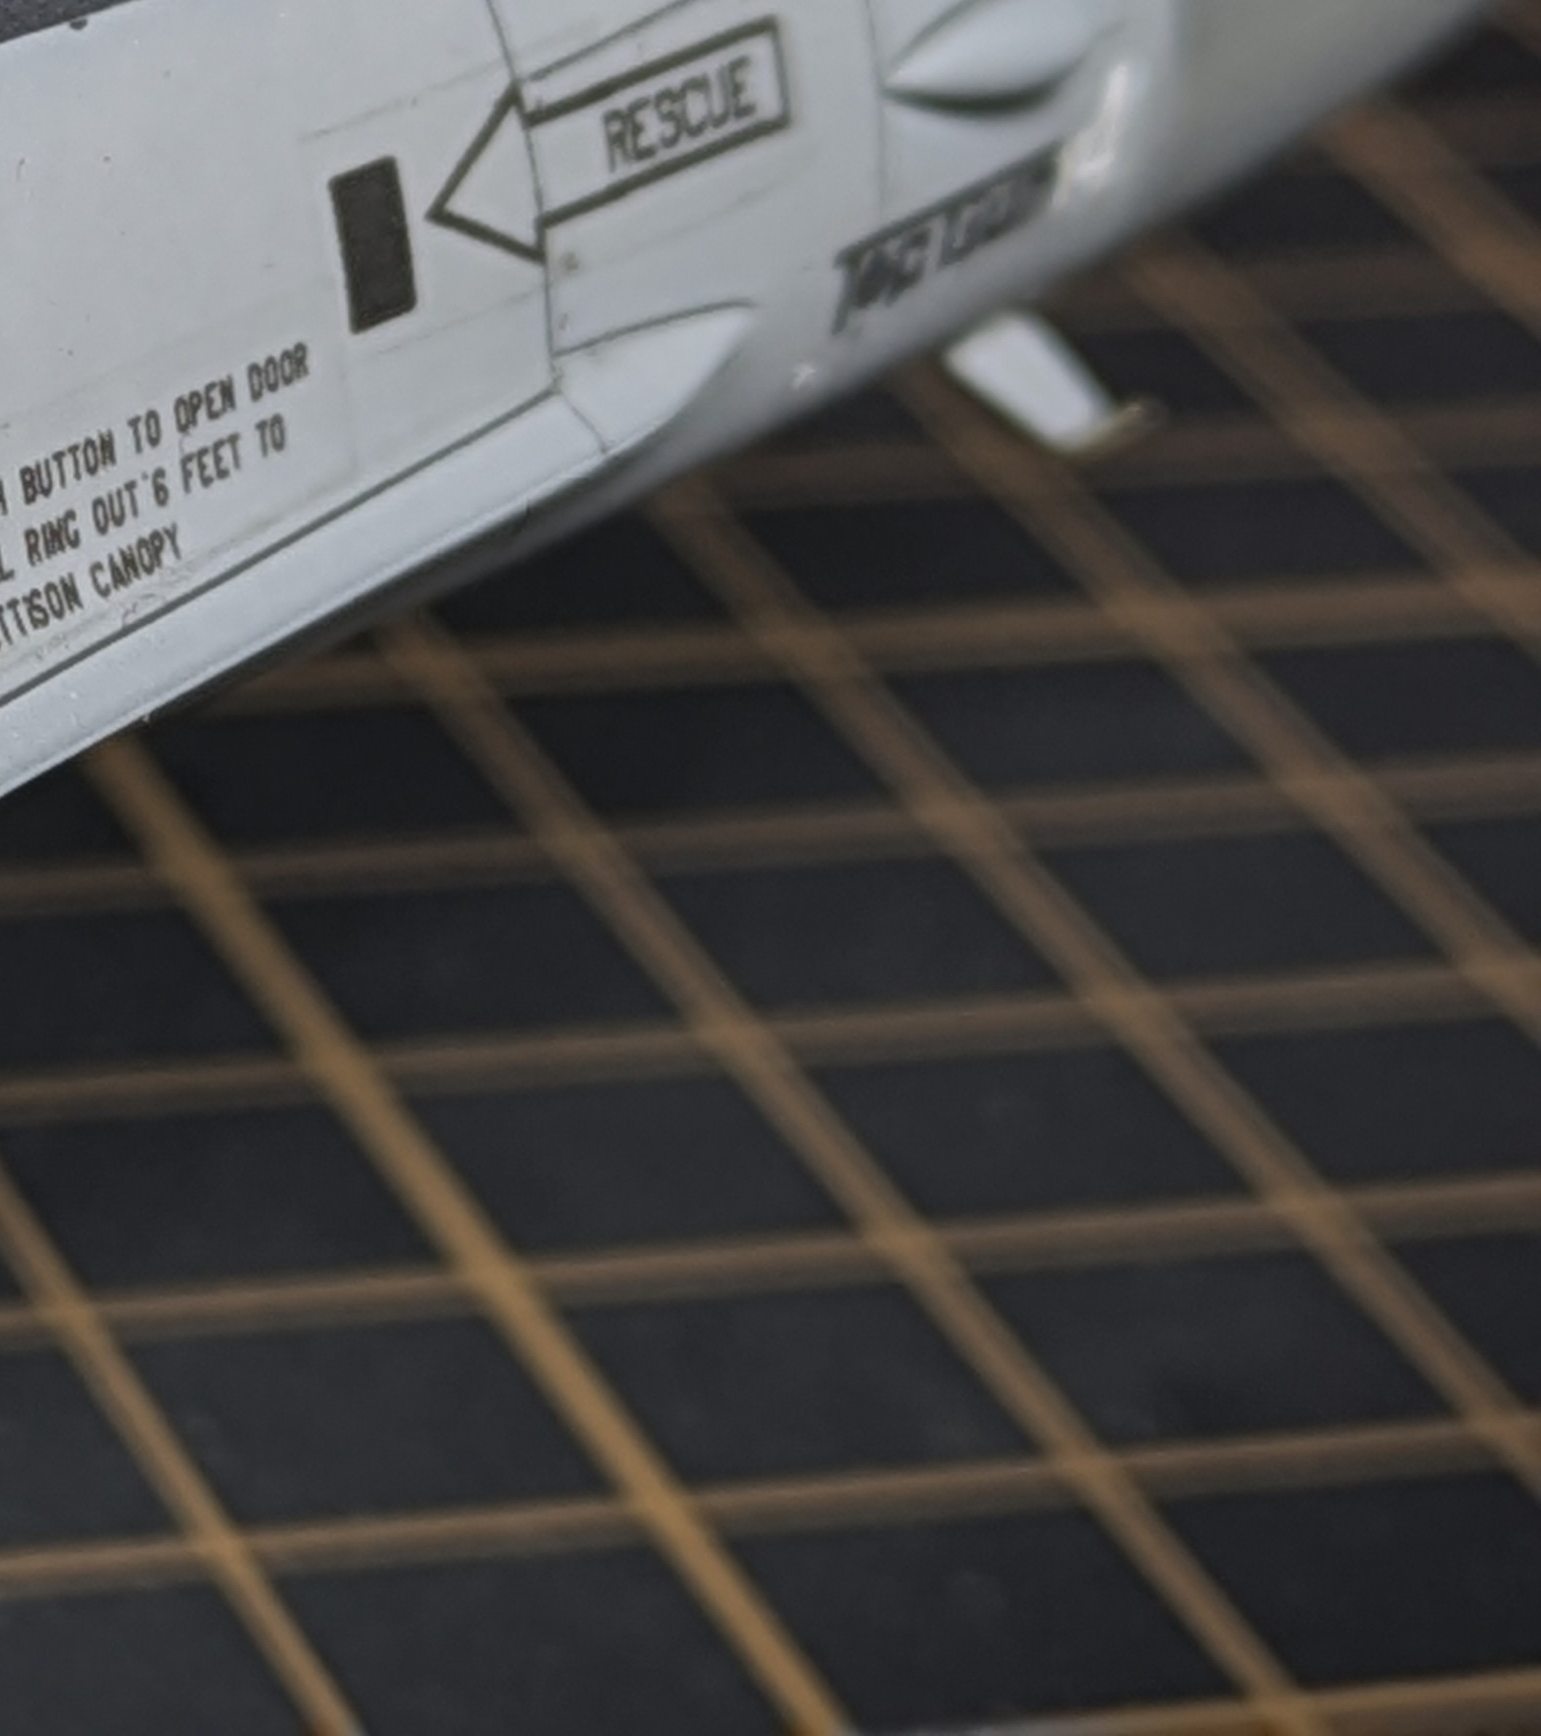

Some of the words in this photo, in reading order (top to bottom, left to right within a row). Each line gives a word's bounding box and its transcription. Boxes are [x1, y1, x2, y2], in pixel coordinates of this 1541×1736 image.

[602, 55, 756, 174] RESCUE
[19, 428, 117, 506] BUTTON
[127, 409, 162, 455] TO
[173, 375, 237, 434] OPEN
[246, 341, 310, 403] DOOR
[24, 509, 81, 566] RING
[92, 480, 140, 537] OUT
[152, 467, 170, 508] 6
[180, 432, 243, 494] FEET
[255, 412, 287, 458] TO
[89, 521, 183, 600] CANOPY
